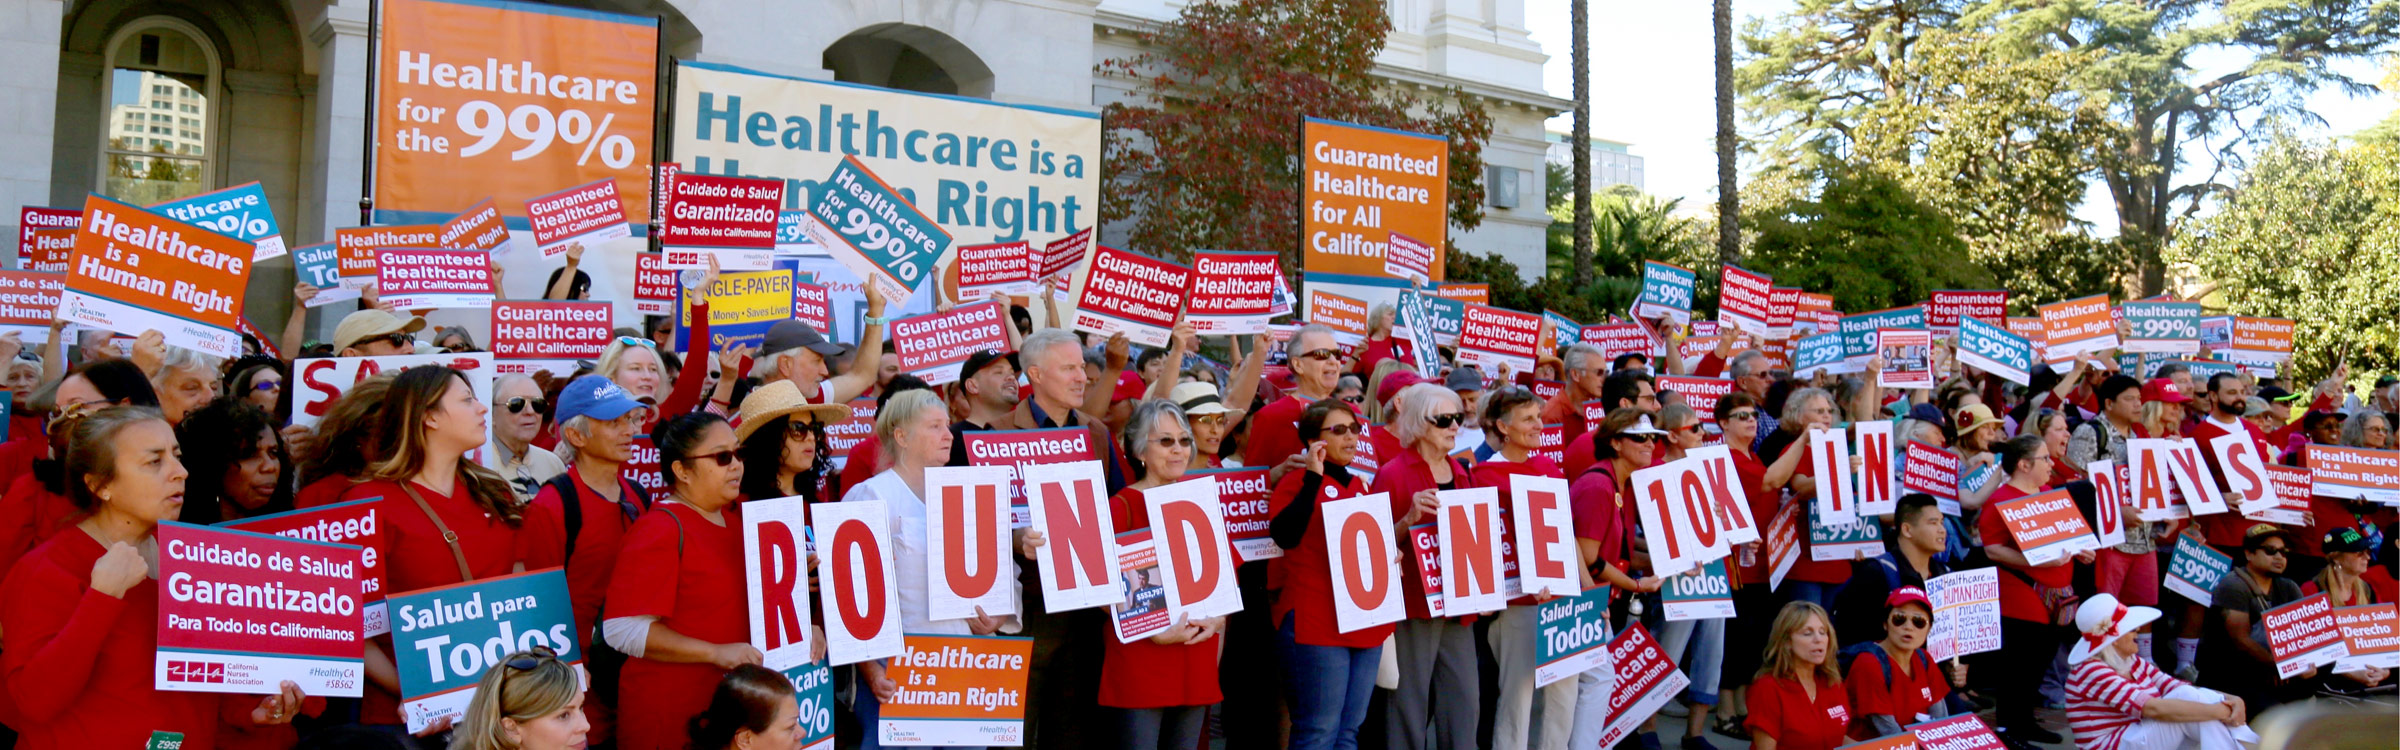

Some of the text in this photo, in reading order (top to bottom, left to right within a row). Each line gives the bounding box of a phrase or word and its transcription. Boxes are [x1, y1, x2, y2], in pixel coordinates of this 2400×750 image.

[398, 50, 638, 105] Healthcare
[397, 97, 446, 124] for
[396, 100, 635, 170] the 99%
[696, 91, 1084, 179] Healthcare is a
[1314, 141, 1439, 178] Guaranteed
[677, 182, 779, 201] Cuidado de Salud
[1313, 170, 1430, 205] Healthcare
[530, 182, 615, 217] Guaranteed
[825, 188, 847, 211] for
[936, 178, 1082, 244] Right
[533, 197, 619, 231] Healthcare
[673, 200, 776, 223] Garantizado
[835, 168, 937, 255] Healthcare
[1312, 200, 1381, 228] for All
[538, 211, 623, 242] for All Californians
[670, 226, 772, 239] Para Todo los Californianos
[89, 209, 244, 275] Healthcare
[340, 230, 436, 248] Healthcare
[817, 201, 839, 225] the
[840, 208, 918, 282] 99%
[105, 242, 139, 267] is a
[380, 251, 485, 266] Guaranteed
[960, 244, 1027, 260] Guaranteed
[381, 265, 487, 281] Healthcare
[960, 257, 1027, 272] Healthcare
[1097, 251, 1187, 288] Guaranteed
[1197, 257, 1274, 275] Guaranteed
[78, 255, 234, 315] Human Right
[383, 279, 489, 292] for All Californians
[961, 269, 1028, 284] for Californians
[1195, 275, 1272, 298] Healthcare
[1646, 281, 1658, 292] for
[1647, 266, 1693, 289] Healthcare
[1725, 270, 1770, 294] Guaranteed
[1090, 273, 1180, 309] Healthcare
[1439, 287, 1487, 297] Healthcare
[1645, 283, 1691, 309] the 99%
[1722, 283, 1768, 308] Healthcare
[1934, 293, 2004, 305] Guaranteed
[496, 305, 607, 322] Guaranteed
[713, 306, 790, 321] Money Saves Lives
[1084, 291, 1174, 323] for All Californians
[1192, 296, 1270, 310] for All Californians
[1314, 295, 1366, 316] Healthcare
[1433, 303, 1452, 313] para
[1736, 300, 1767, 320] Californians
[1933, 303, 2003, 316] Healthcare
[2043, 302, 2107, 321] Healthcare
[2126, 306, 2197, 317] Healthcare
[896, 305, 998, 338] Guaranteed
[1313, 312, 1366, 332] Human Right
[1468, 308, 1539, 331] Guaranteed
[1843, 311, 1921, 333] Healthcare
[2046, 319, 2111, 340] Human Right
[2144, 318, 2198, 339] 99%
[2236, 320, 2291, 333] Healthcare
[183, 326, 226, 342] #HealthyCA
[496, 323, 608, 342] Healthcare
[899, 324, 1000, 355] Healthcare
[1466, 321, 1536, 344] Healthcare
[1583, 328, 1645, 342] Guaranteed
[1845, 335, 1861, 347] for
[1962, 319, 2029, 352] Healthcare
[2234, 336, 2290, 350] Human Right
[197, 340, 226, 353] #SB562
[495, 342, 607, 355] for All Californians
[1463, 335, 1534, 355] for Californians
[1978, 337, 2028, 371] 99%
[904, 351, 938, 368] for All
[1659, 379, 1732, 397] Guaranteed
[971, 435, 1087, 459] Guaranteed
[1908, 443, 1956, 467] Guaranteed
[2310, 449, 2398, 468] Healthcare
[1907, 460, 1956, 485] Healthcare
[2312, 467, 2400, 488] Human Right
[1924, 478, 1957, 497] Californians
[2002, 496, 2072, 522] Healthcare
[2016, 517, 2085, 544] Human Right
[168, 539, 354, 580] Cuidado de Salud
[2177, 537, 2228, 573] Healthcare
[1944, 574, 1986, 587] Healthcare
[168, 571, 356, 617] Garantizado
[1944, 585, 1972, 606] HUMAN
[1973, 582, 1998, 601] RIGHT
[398, 591, 537, 633] Salud para
[1541, 598, 1594, 626] Salud para
[2266, 596, 2329, 629] Guaranteed
[2370, 609, 2396, 621] Salud
[168, 613, 355, 643] Para Todo los Californianos
[1543, 618, 1604, 657] Todos
[2270, 613, 2334, 644] Healthcare
[2297, 628, 2339, 651] Californians
[894, 645, 1023, 671] Healthcare
[227, 663, 355, 680] California #HealthyCA
[227, 670, 250, 679] Nurses
[908, 670, 937, 685] is a
[227, 677, 354, 691] Association #SB562
[888, 686, 1019, 711] Human Right
[979, 725, 1018, 736] #HealthyCA
[1915, 717, 1984, 743] Guaranteed
